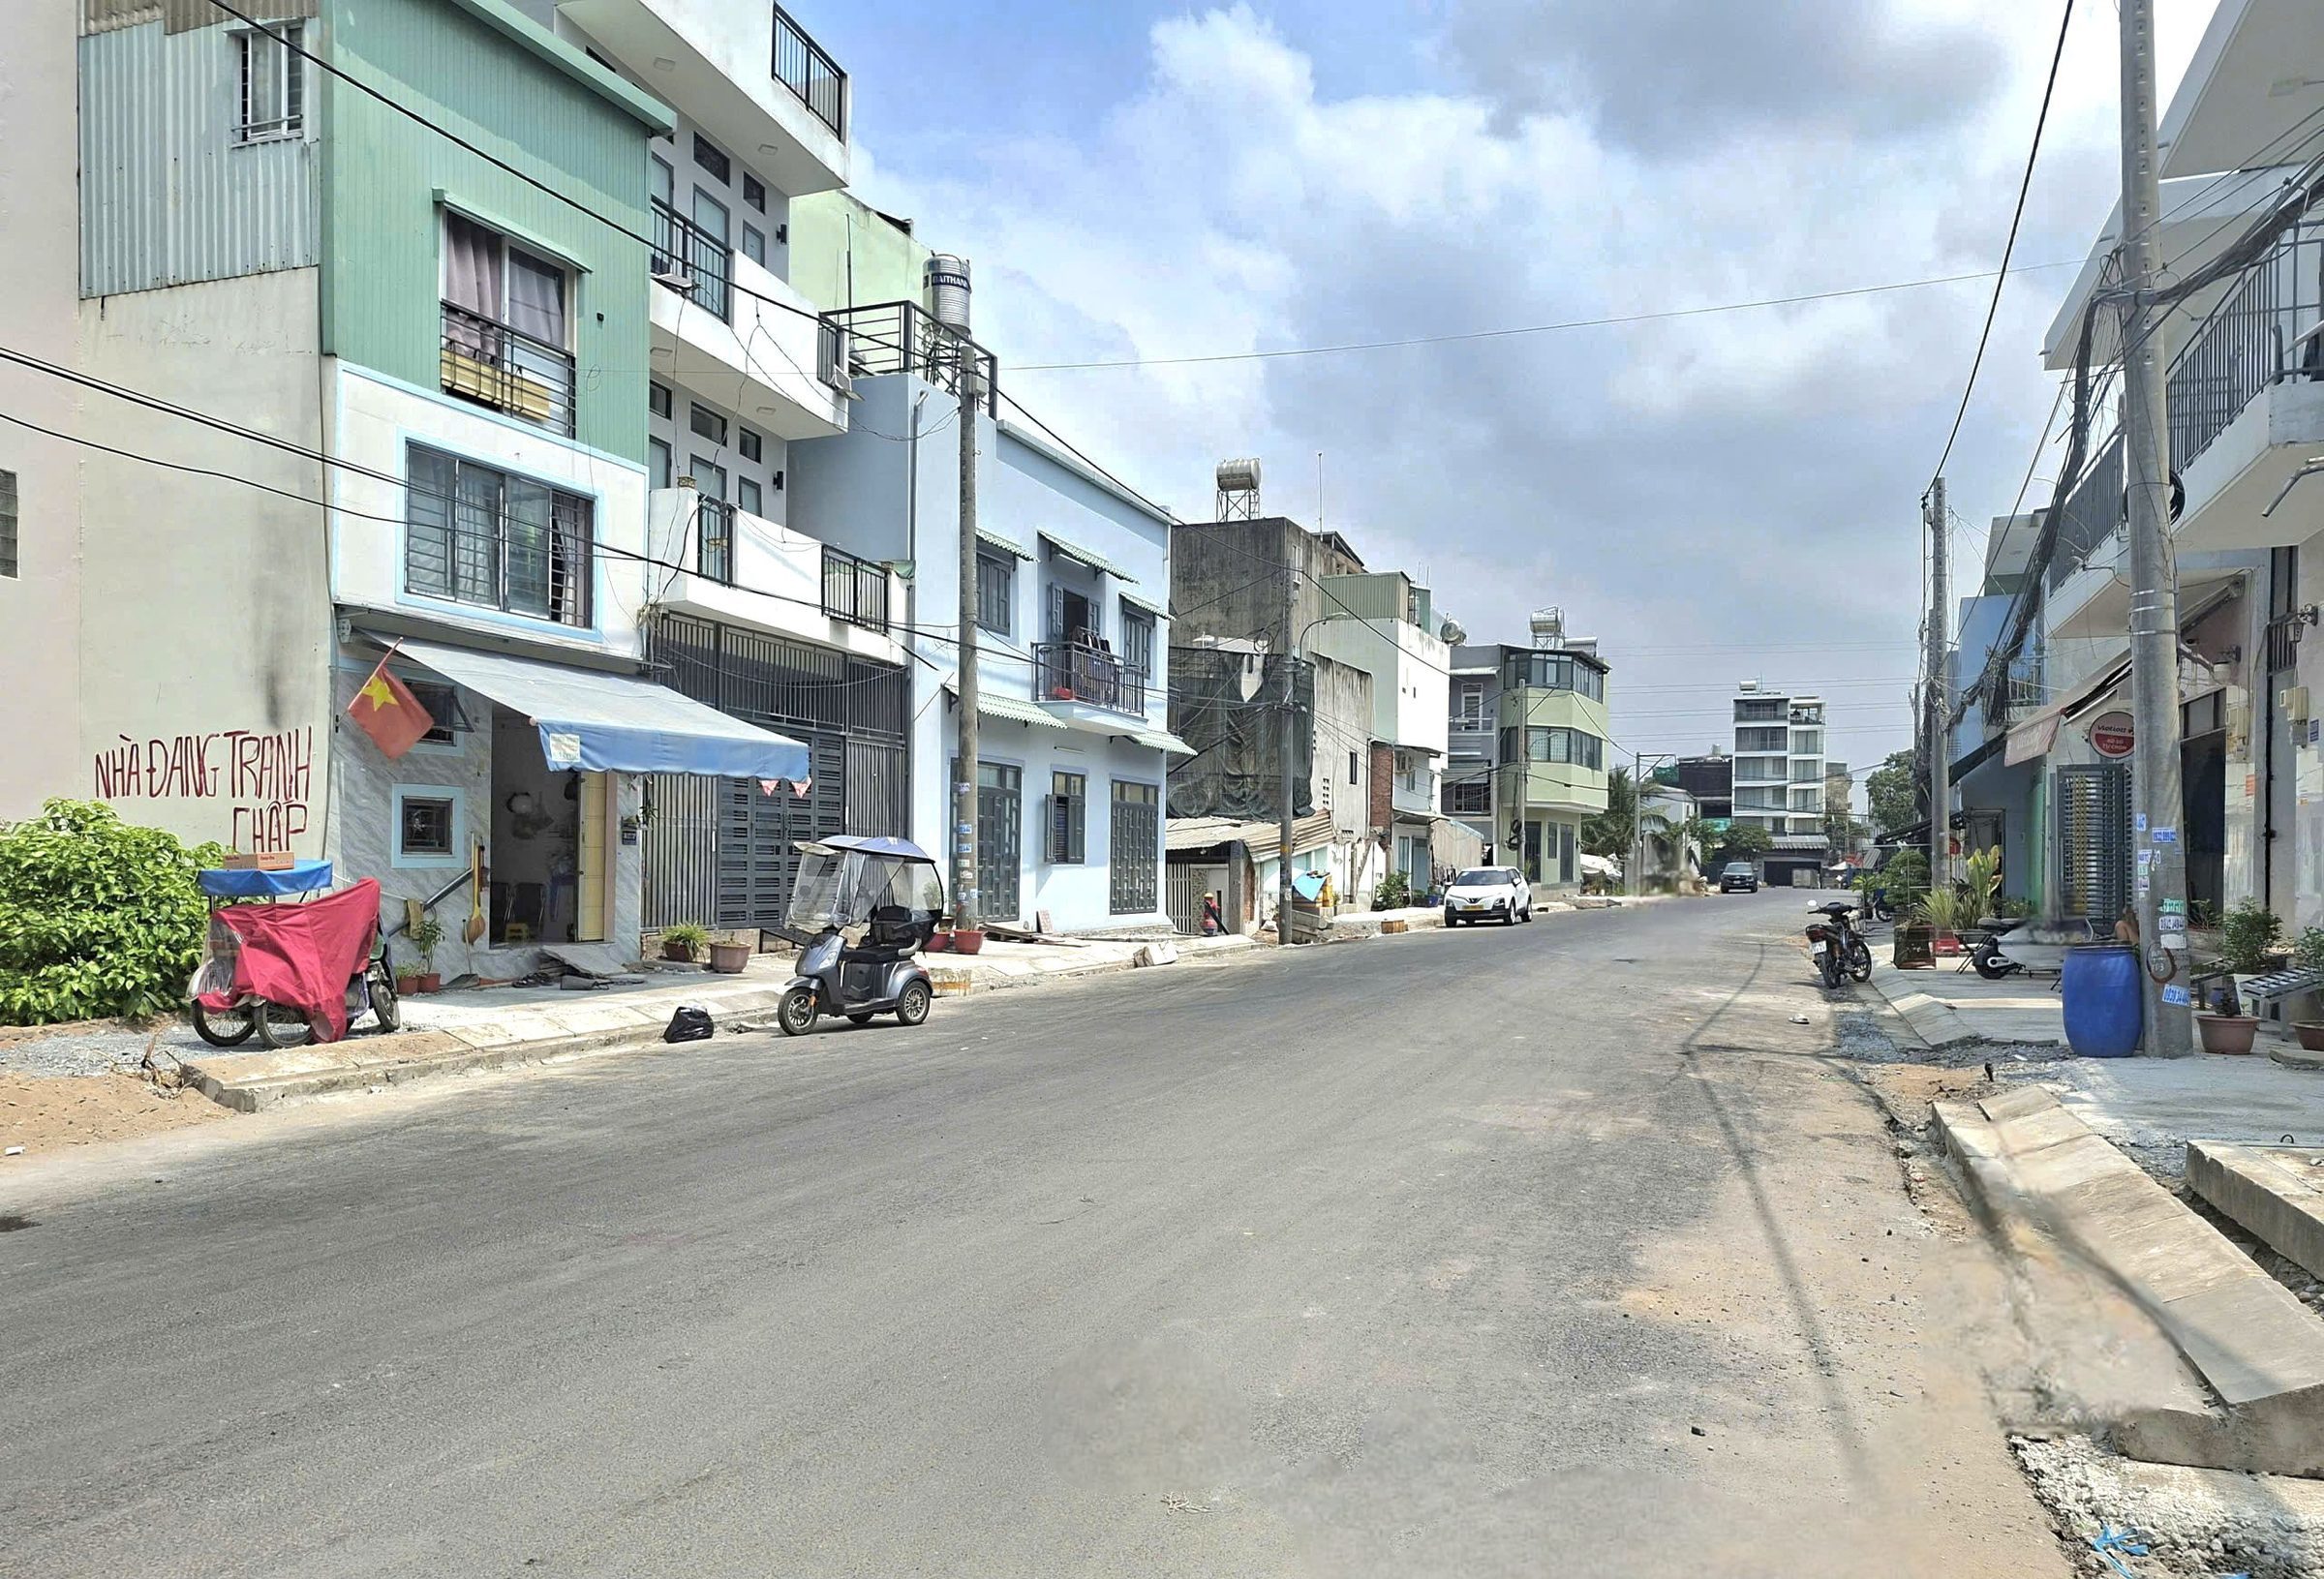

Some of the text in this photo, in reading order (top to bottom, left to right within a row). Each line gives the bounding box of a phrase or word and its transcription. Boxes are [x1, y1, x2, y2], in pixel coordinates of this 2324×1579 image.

[95, 726, 312, 802] NHÀ ĐANG TRANH
[232, 800, 308, 852] CHẤP
